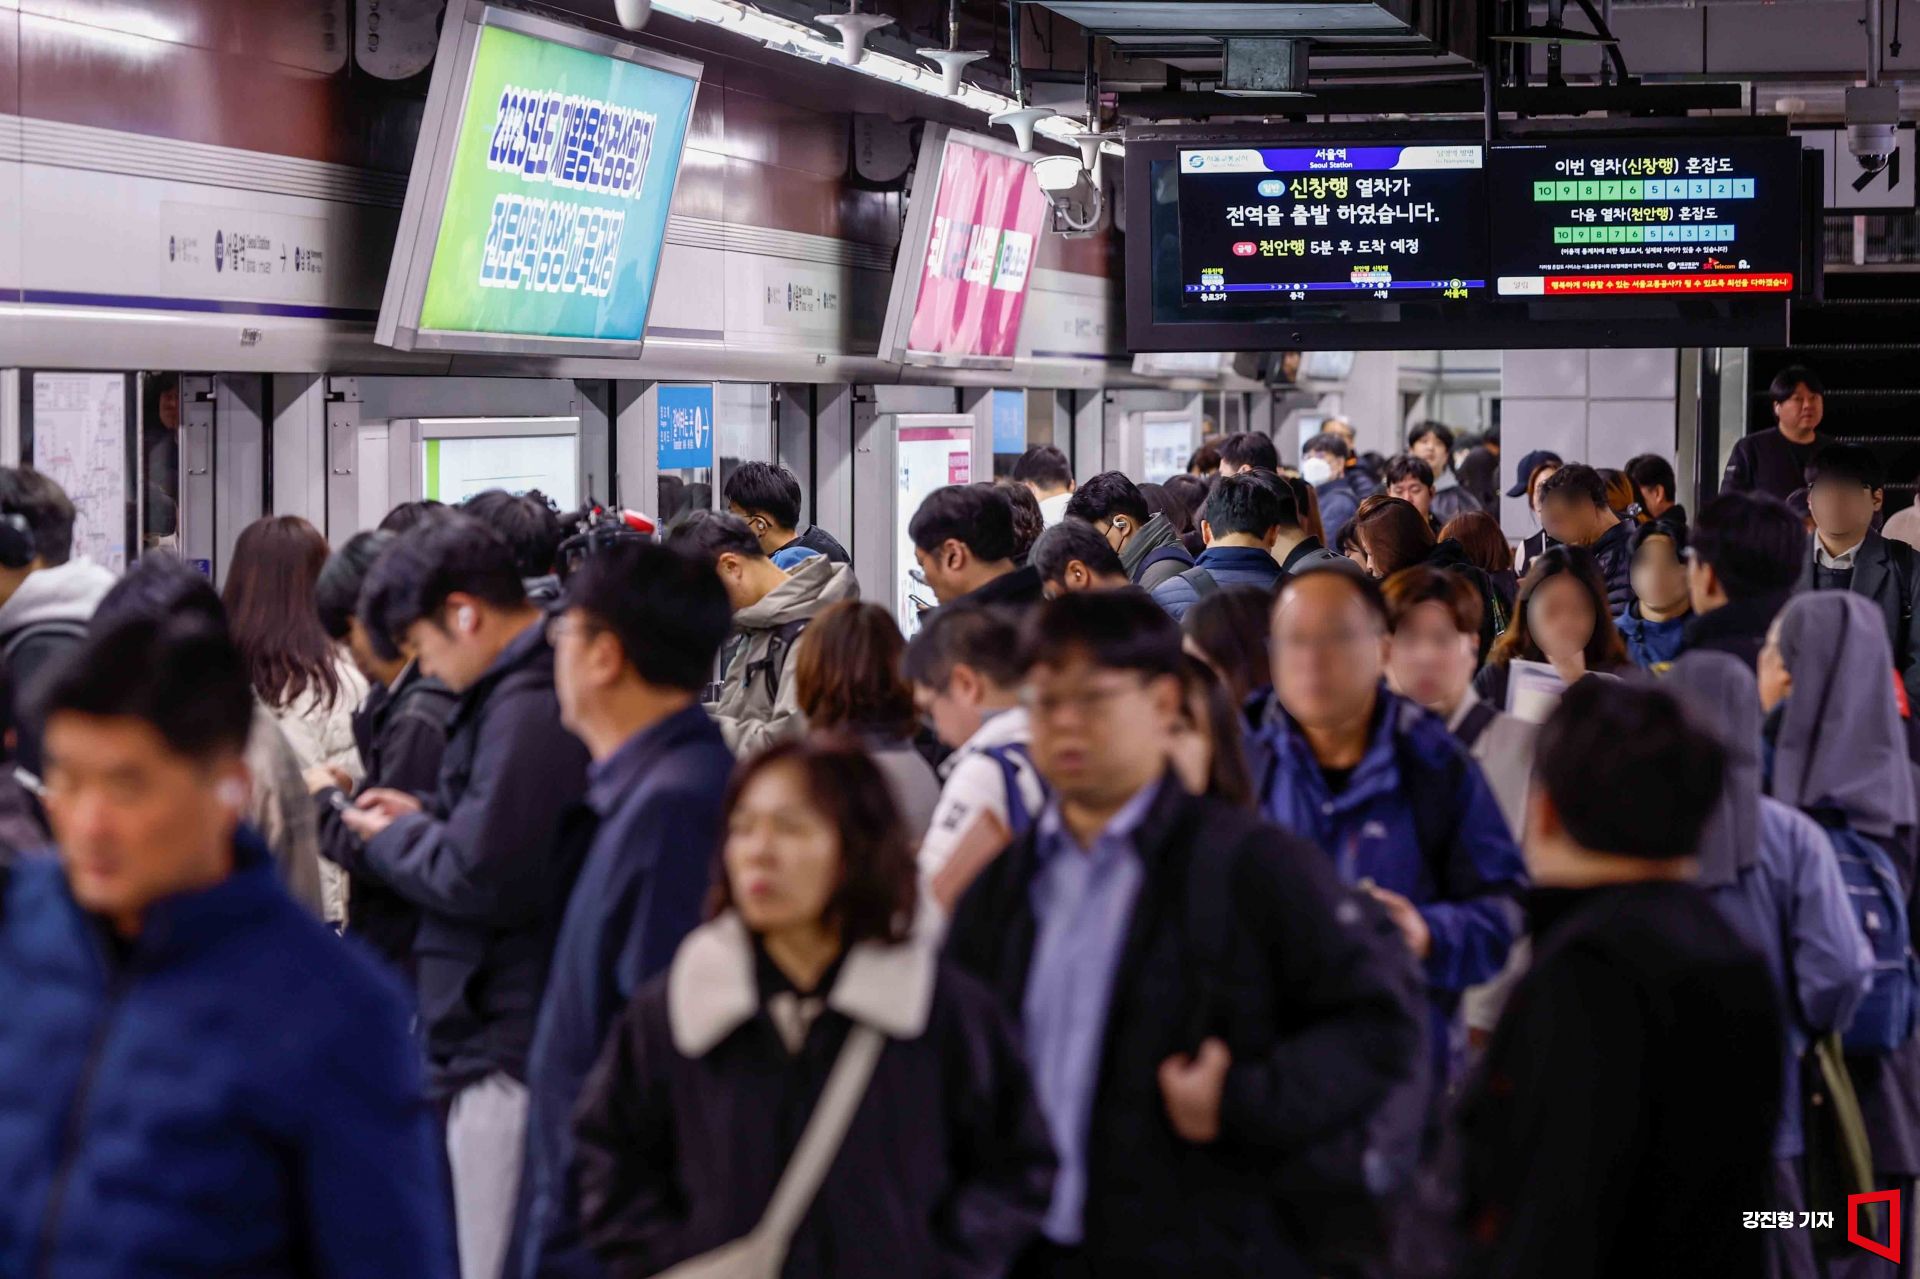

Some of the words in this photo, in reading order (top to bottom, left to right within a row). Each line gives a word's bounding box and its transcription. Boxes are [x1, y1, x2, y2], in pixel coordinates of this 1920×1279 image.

[487, 84, 564, 182] 2025년도
[1315, 148, 1347, 161] 서울역
[1329, 161, 1353, 169] Station
[1555, 158, 1584, 176] 이번
[1590, 157, 1679, 176] 열차(신창행)
[1685, 157, 1734, 174] 혼잡도
[1289, 177, 1348, 199] 신창행
[1355, 177, 1411, 198] 열차가
[1538, 187, 1552, 196] 10
[1563, 186, 1570, 195] 9
[1585, 186, 1592, 195] 8
[1608, 186, 1614, 194] 7
[1629, 186, 1636, 194] 6
[1651, 185, 1658, 194] 5
[1673, 185, 1680, 193] 4
[1695, 184, 1702, 193] 3
[1718, 184, 1725, 193] 2
[1741, 184, 1746, 192] 1
[1226, 204, 1284, 227] 전역을
[1290, 204, 1330, 226] 출발
[1336, 202, 1440, 225] 하였습니다.
[1571, 207, 1597, 222] 다음
[1600, 206, 1674, 222] 열차(천안행)
[1679, 206, 1718, 221] 혼잡도
[1558, 231, 1569, 239] 10
[1632, 230, 1638, 238] 6
[1704, 229, 1710, 237] 2
[480, 193, 549, 290] 전문인력
[534, 199, 578, 293] 양성
[561, 206, 625, 297] 교육과정
[1259, 239, 1305, 256] 천안행
[1310, 240, 1334, 256] 5분
[1338, 239, 1353, 255] 후
[1357, 239, 1386, 255] 도착
[1390, 238, 1419, 254] 예정
[1663, 246, 1681, 254] 차이가
[1551, 280, 1581, 290] 행복하게
[1582, 280, 1604, 290] 이용할
[1606, 280, 1614, 289] 수
[1615, 280, 1630, 289] 있는
[1632, 279, 1682, 289] 서울교통공사가
[1693, 279, 1701, 288] 수
[1703, 278, 1725, 288] 있도록
[1727, 278, 1749, 288] 최선을
[1200, 292, 1227, 302] 종로3가
[1289, 291, 1305, 301] 종각
[1373, 289, 1388, 299] 시청
[1443, 288, 1469, 299] 서울역
